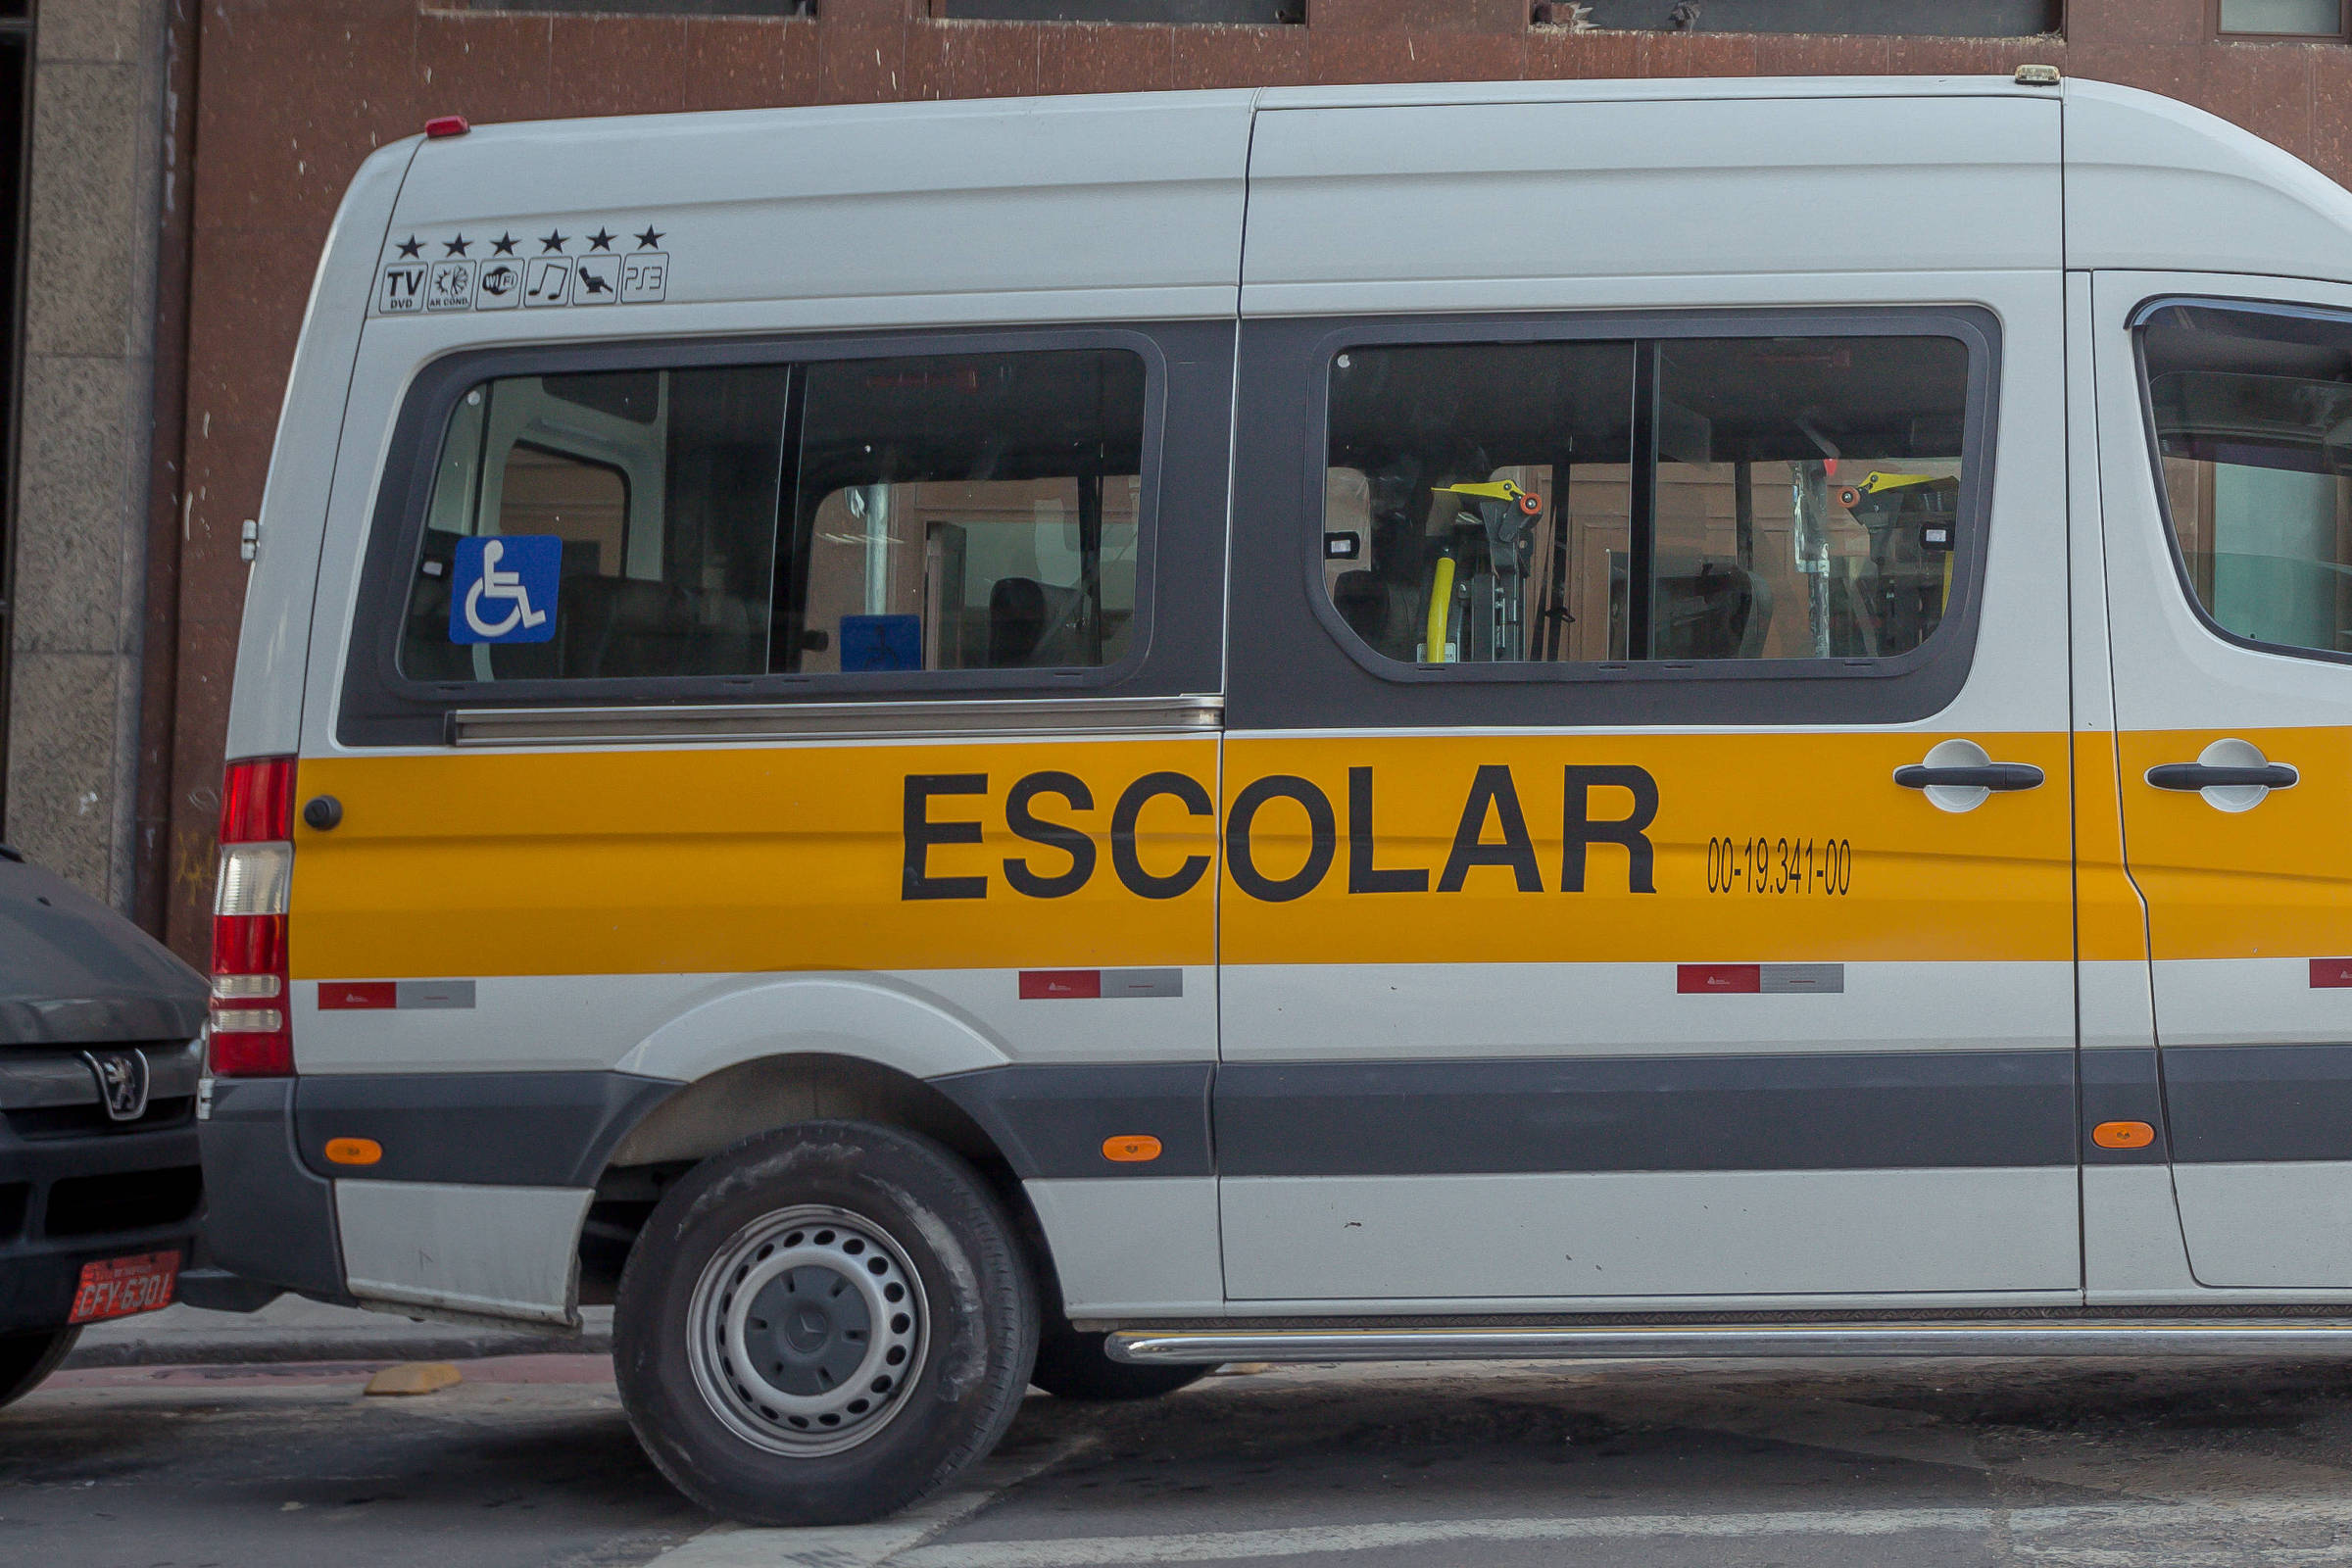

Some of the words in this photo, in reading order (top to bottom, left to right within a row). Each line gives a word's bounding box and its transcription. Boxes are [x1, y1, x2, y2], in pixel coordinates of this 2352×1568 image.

[388, 270, 423, 296] TV
[624, 266, 662, 291] PS3
[390, 298, 413, 309] DVD
[901, 764, 1660, 902] ESCOLAR
[1707, 837, 1851, 896] 00-19.341-00
